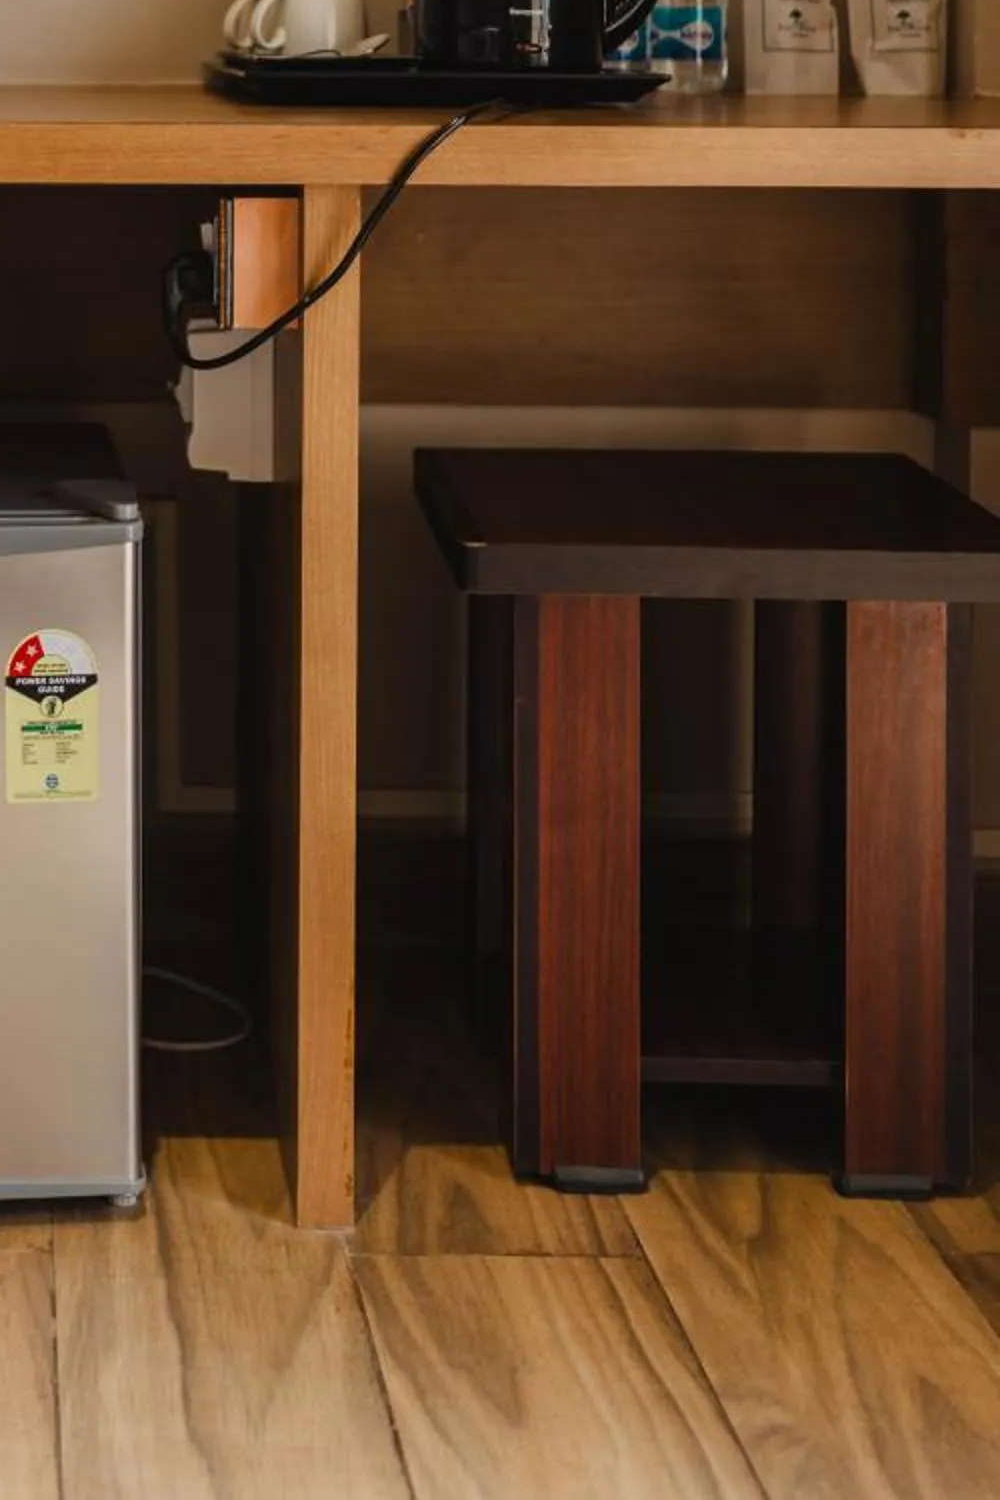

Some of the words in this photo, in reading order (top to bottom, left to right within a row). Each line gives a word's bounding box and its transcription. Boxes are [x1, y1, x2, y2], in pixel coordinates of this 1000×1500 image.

[16, 677, 47, 686] POWER
[48, 676, 87, 685] SAVINGS
[38, 685, 65, 693] GUIDE
